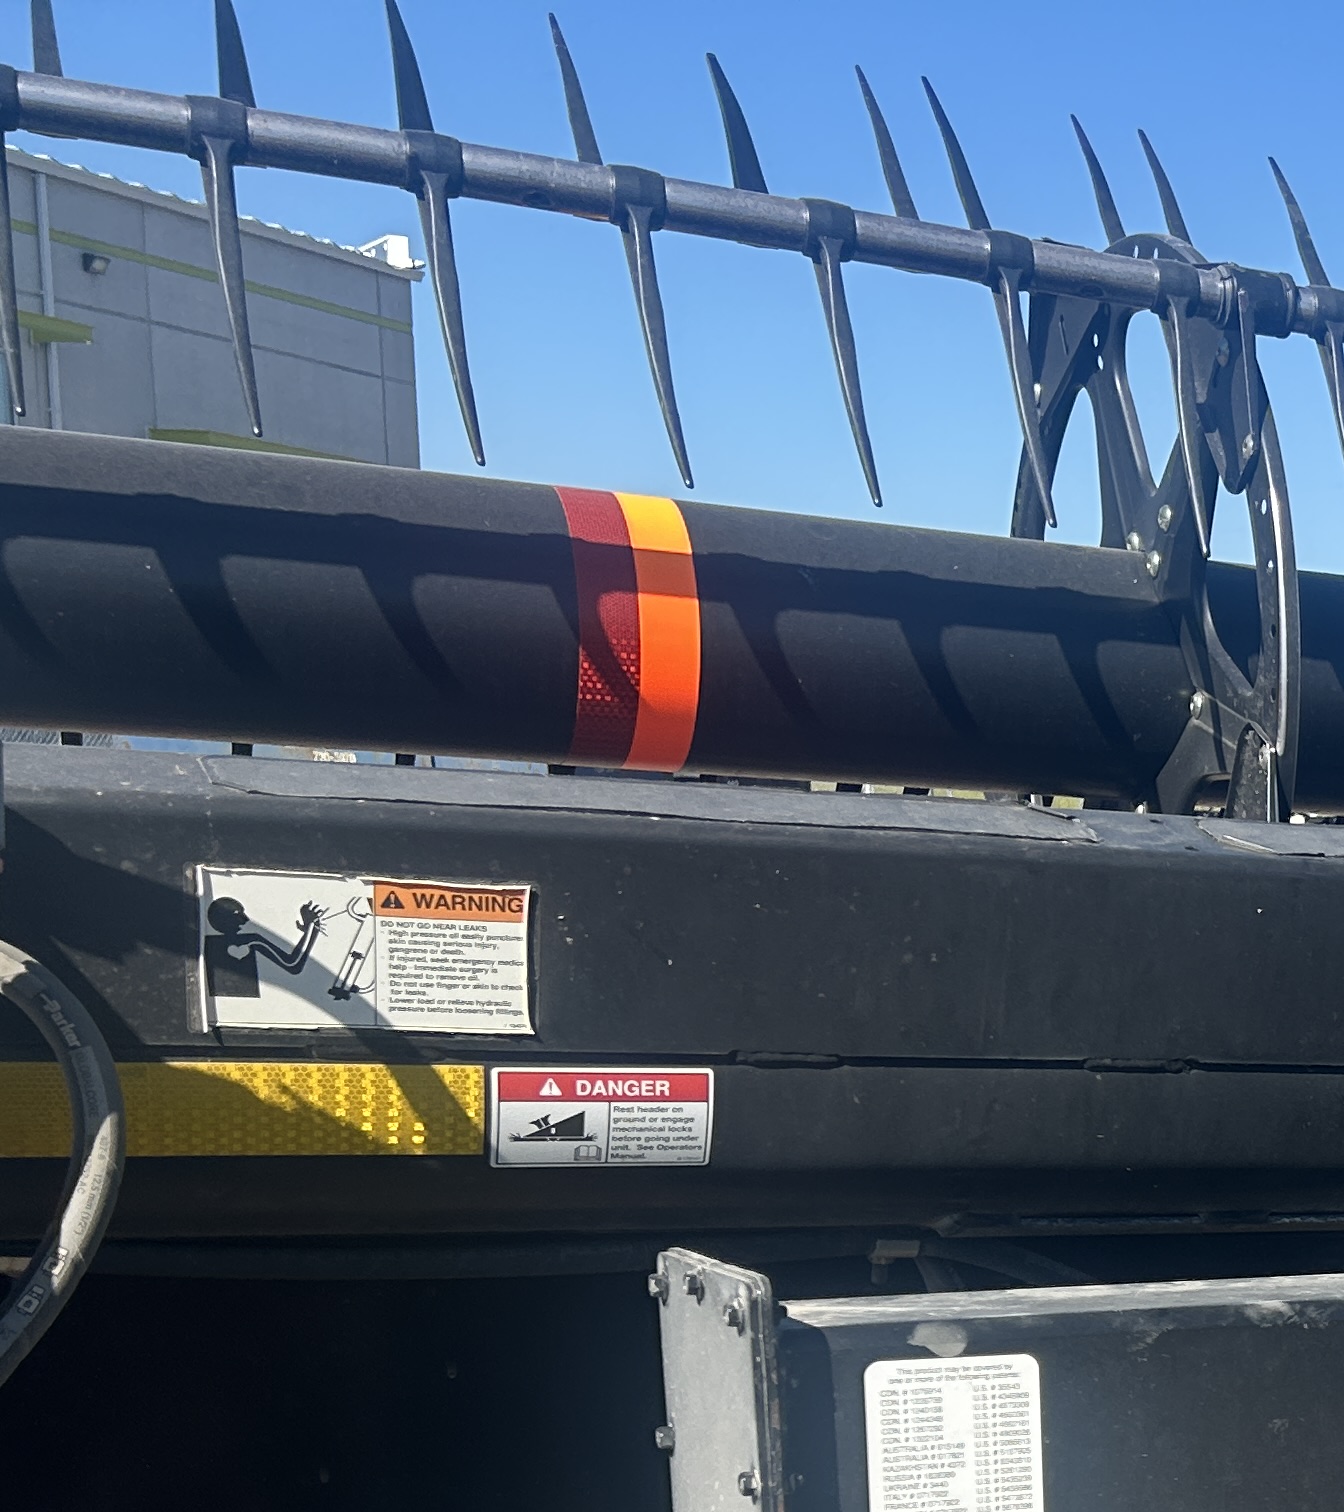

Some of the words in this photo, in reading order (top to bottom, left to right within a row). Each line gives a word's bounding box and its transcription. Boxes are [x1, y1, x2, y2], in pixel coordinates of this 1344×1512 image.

[412, 892, 523, 913] WARNING
[40, 993, 81, 1048] Parker
[577, 1080, 670, 1096] DANGER
[613, 1116, 646, 1125] ground
[645, 1135, 670, 1144] going
